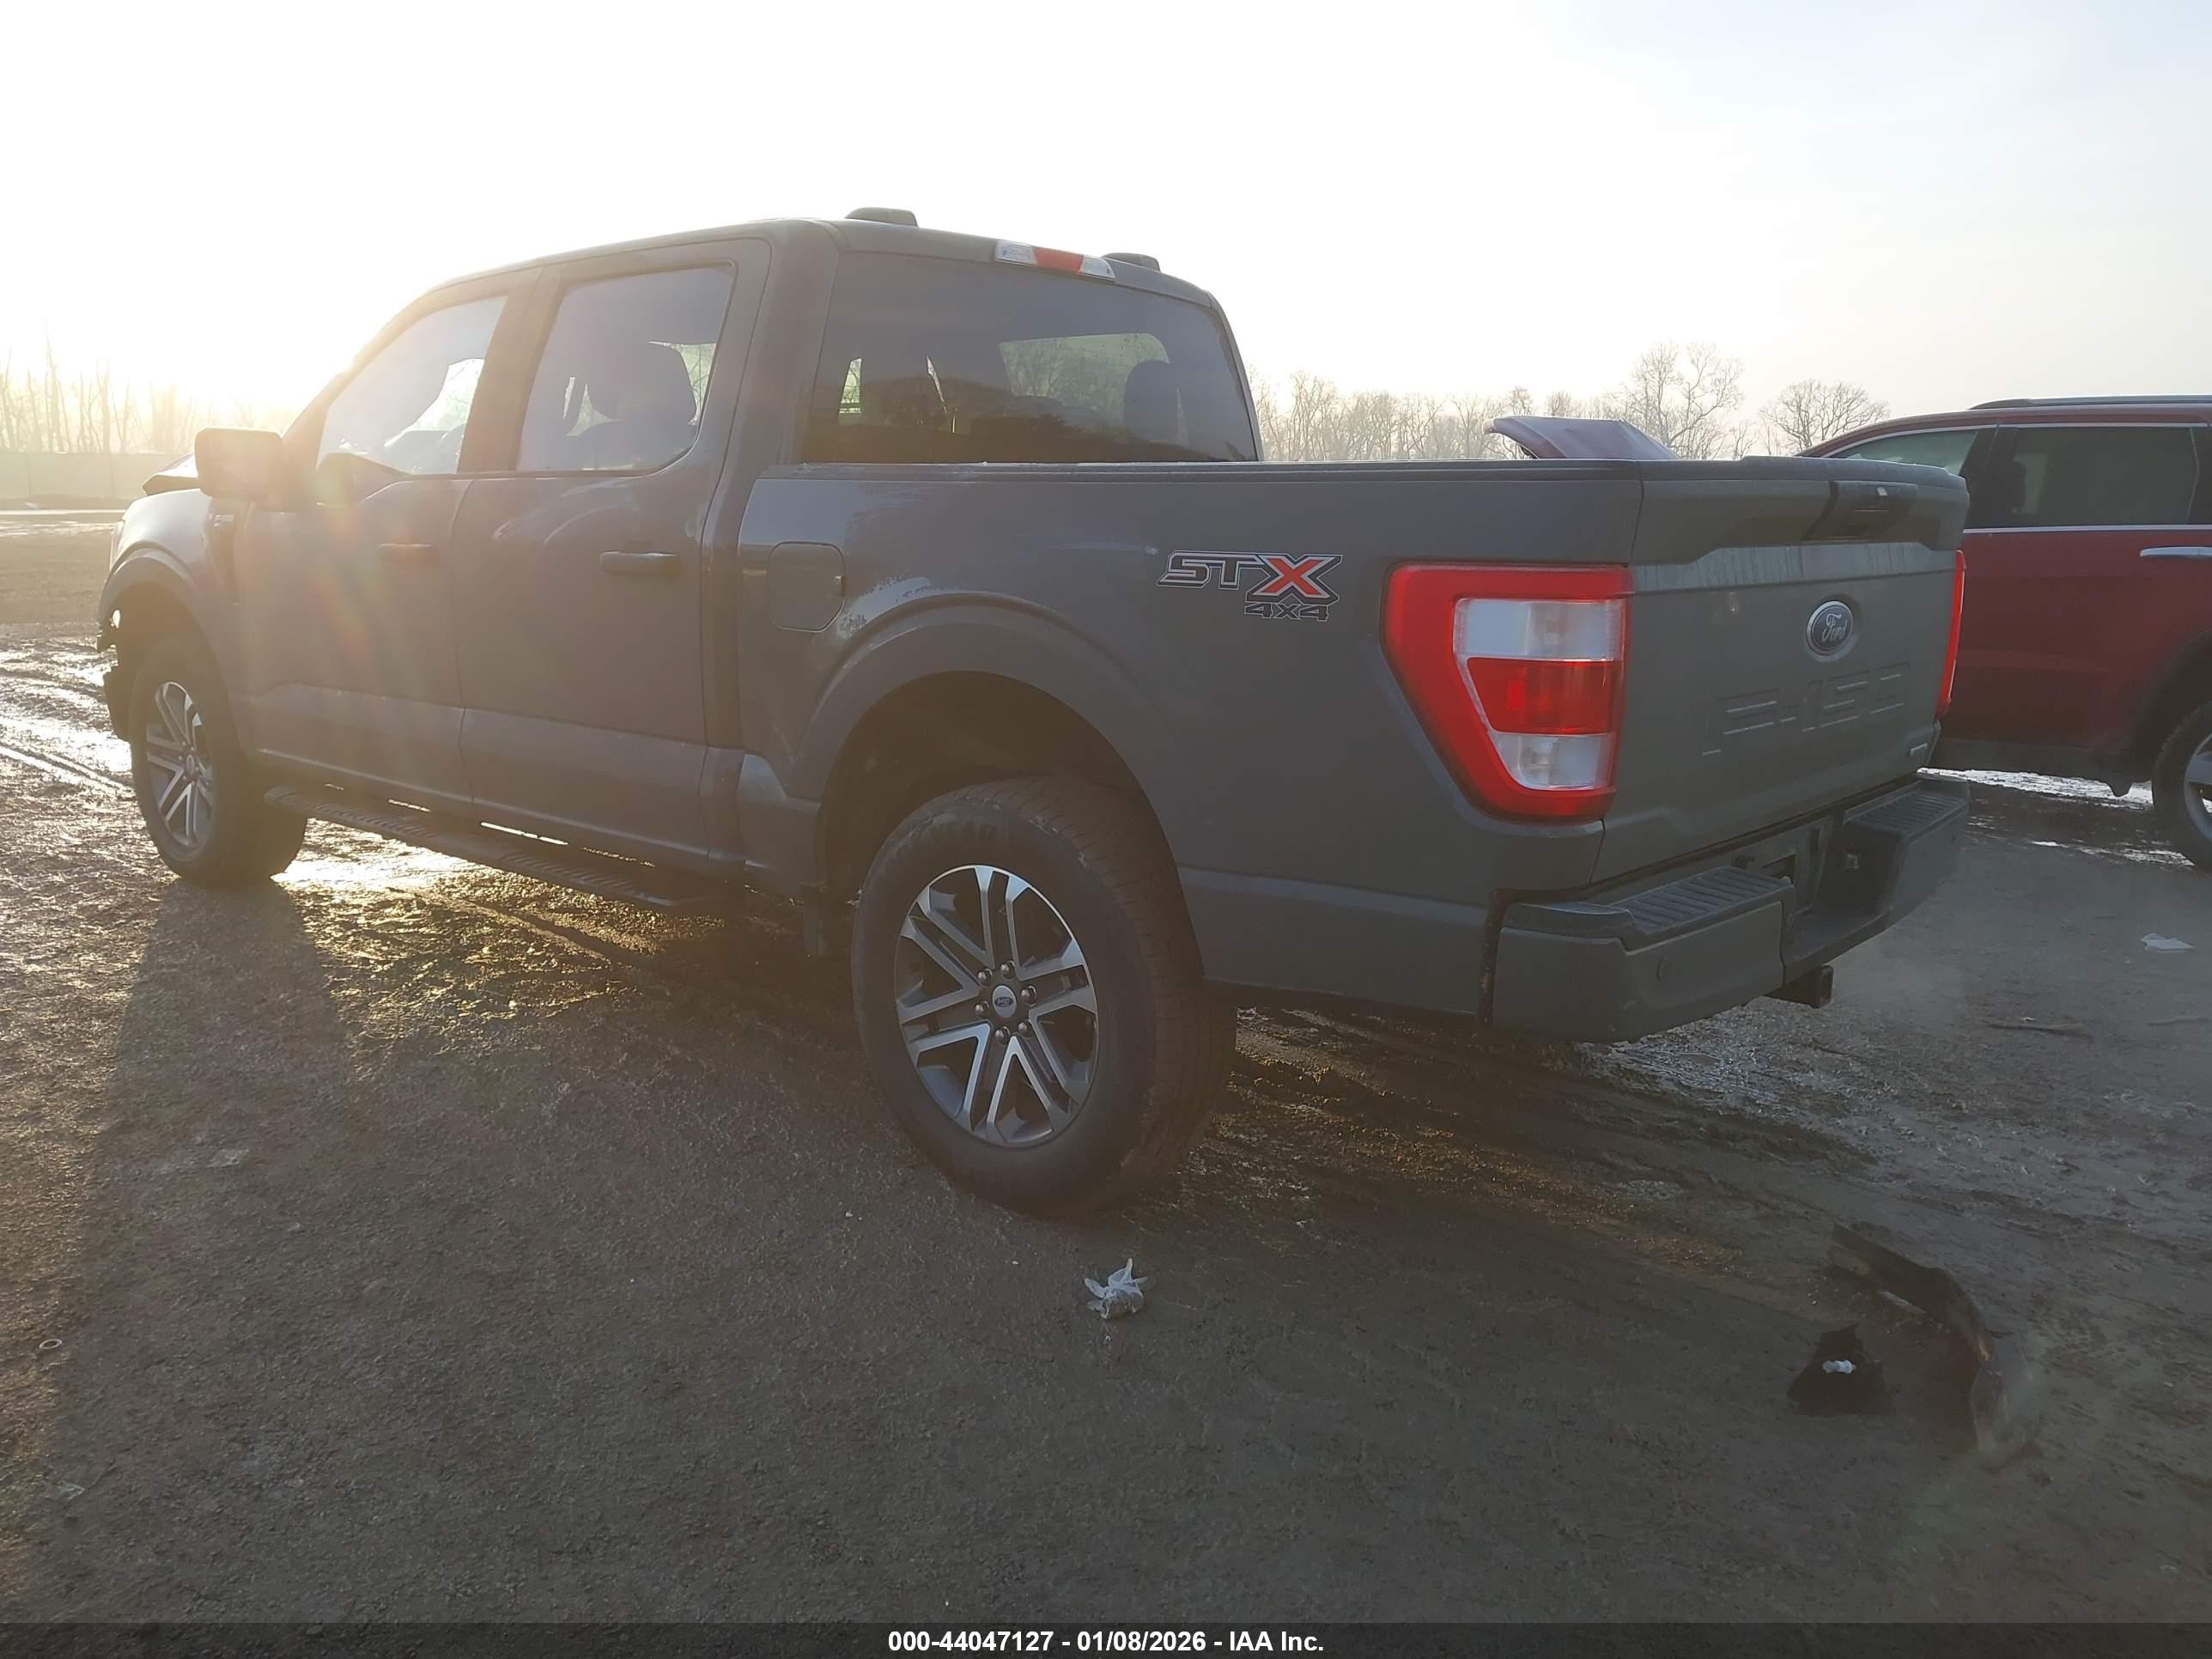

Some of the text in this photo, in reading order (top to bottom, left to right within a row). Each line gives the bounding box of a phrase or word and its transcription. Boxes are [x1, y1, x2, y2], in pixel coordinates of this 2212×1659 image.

[1157, 550, 1343, 605] STX
[1821, 612, 1850, 643] Ford
[1702, 660, 1911, 757] F-150
